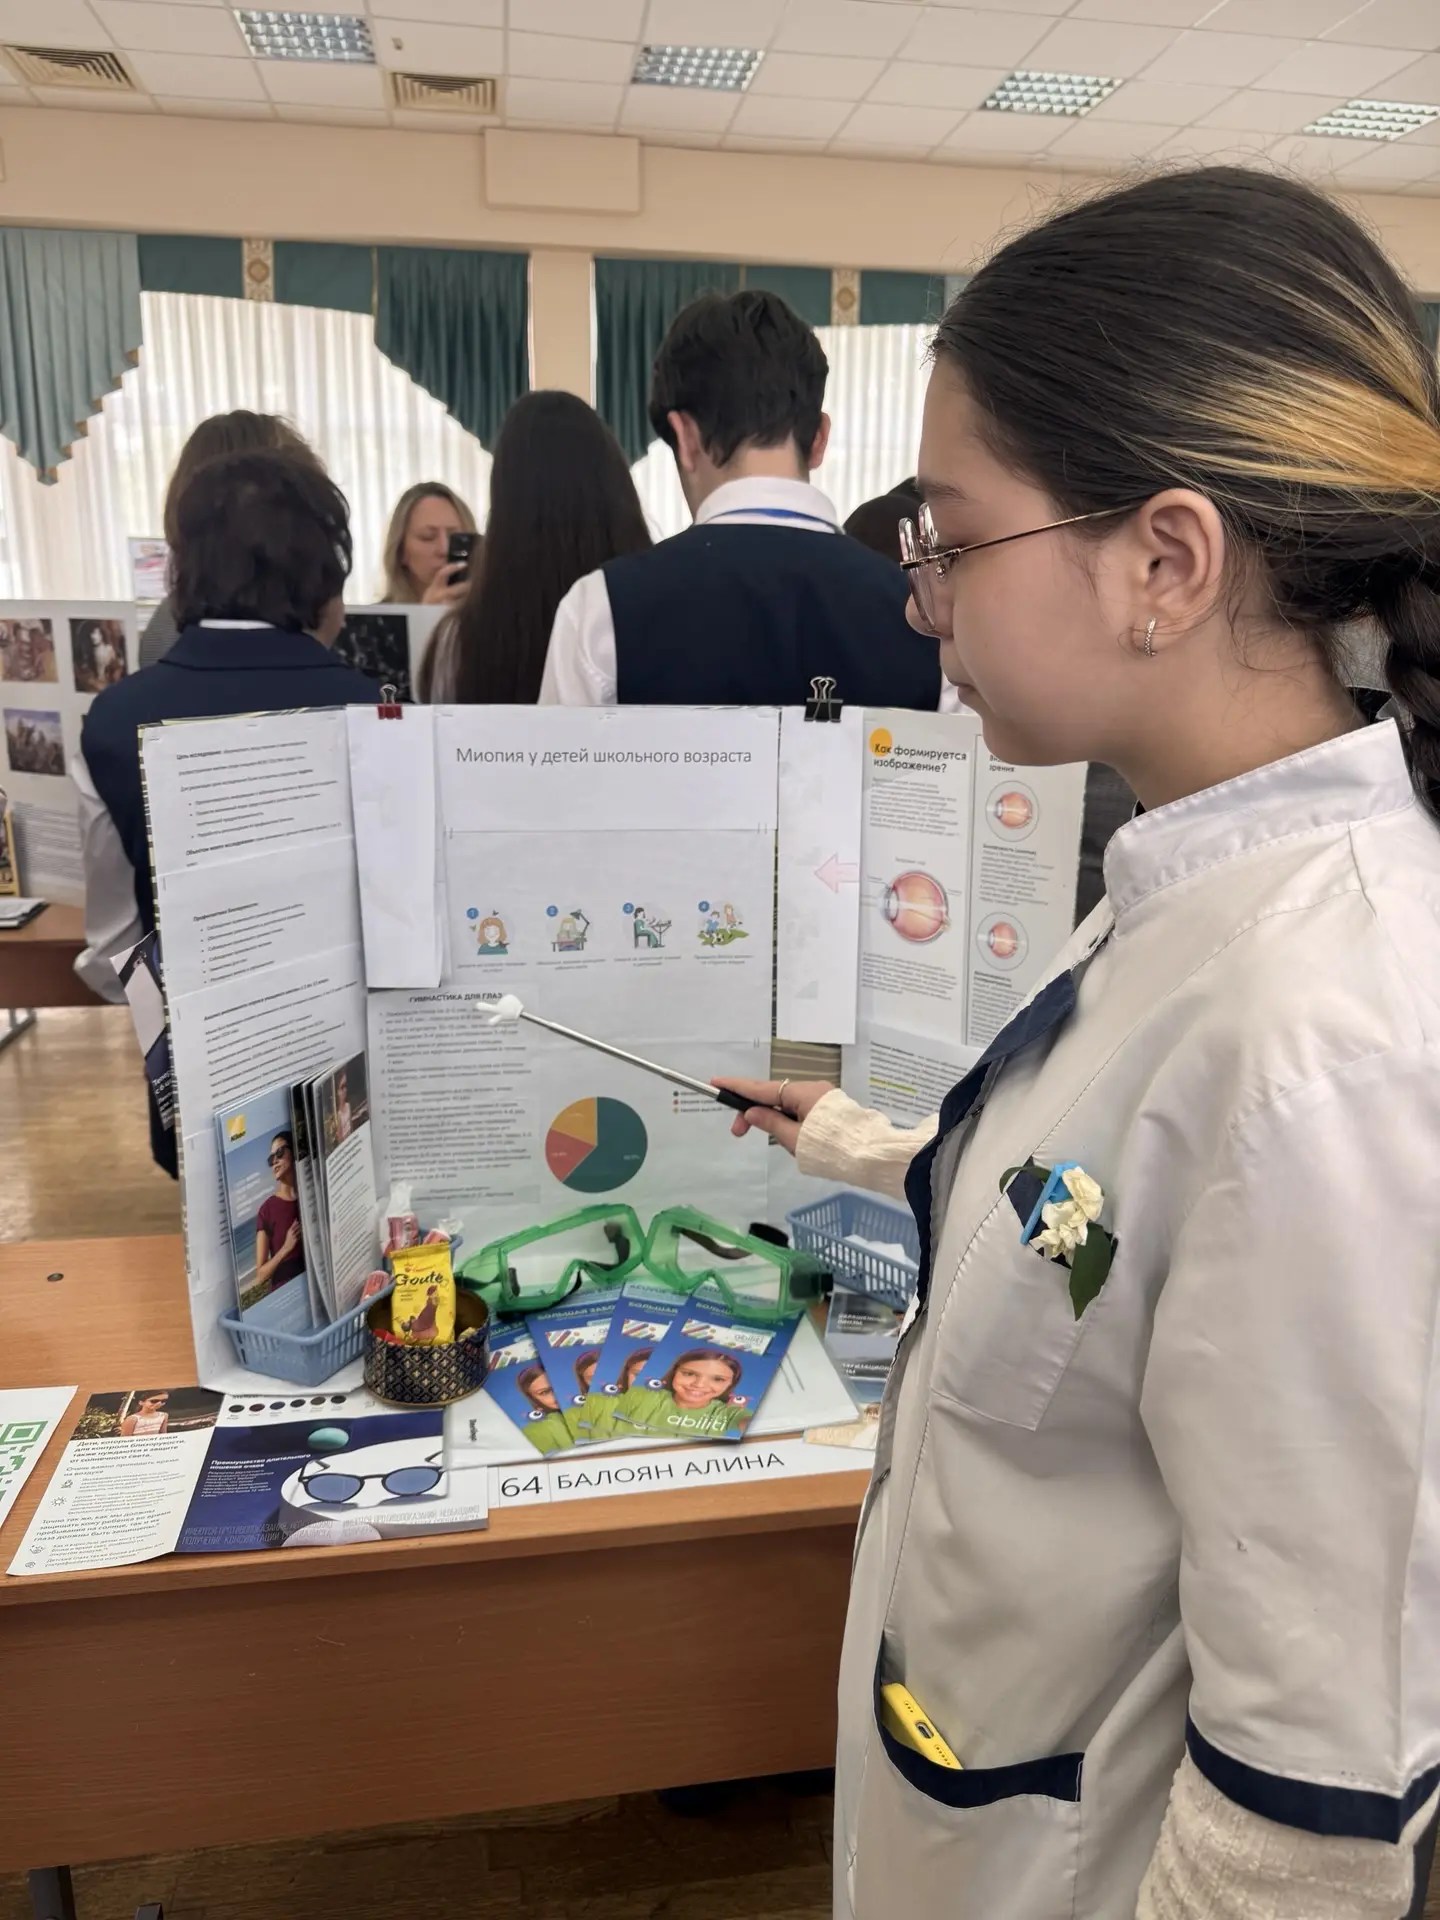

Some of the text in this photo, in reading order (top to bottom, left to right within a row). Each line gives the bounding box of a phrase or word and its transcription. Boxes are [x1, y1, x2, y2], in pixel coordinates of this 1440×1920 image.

[456, 748, 752, 766] Миопия у детей школьного возраста
[874, 743, 967, 762] Как формируется
[873, 758, 948, 774] изображение?
[409, 994, 463, 1003] ГИМНАСТИКА
[464, 993, 481, 1001] ДЛЯ
[395, 1271, 444, 1287] Goute
[667, 1413, 729, 1432] abiliti
[558, 1452, 785, 1490] БАЛОЯН АЛИНА
[501, 1476, 543, 1498] 64
